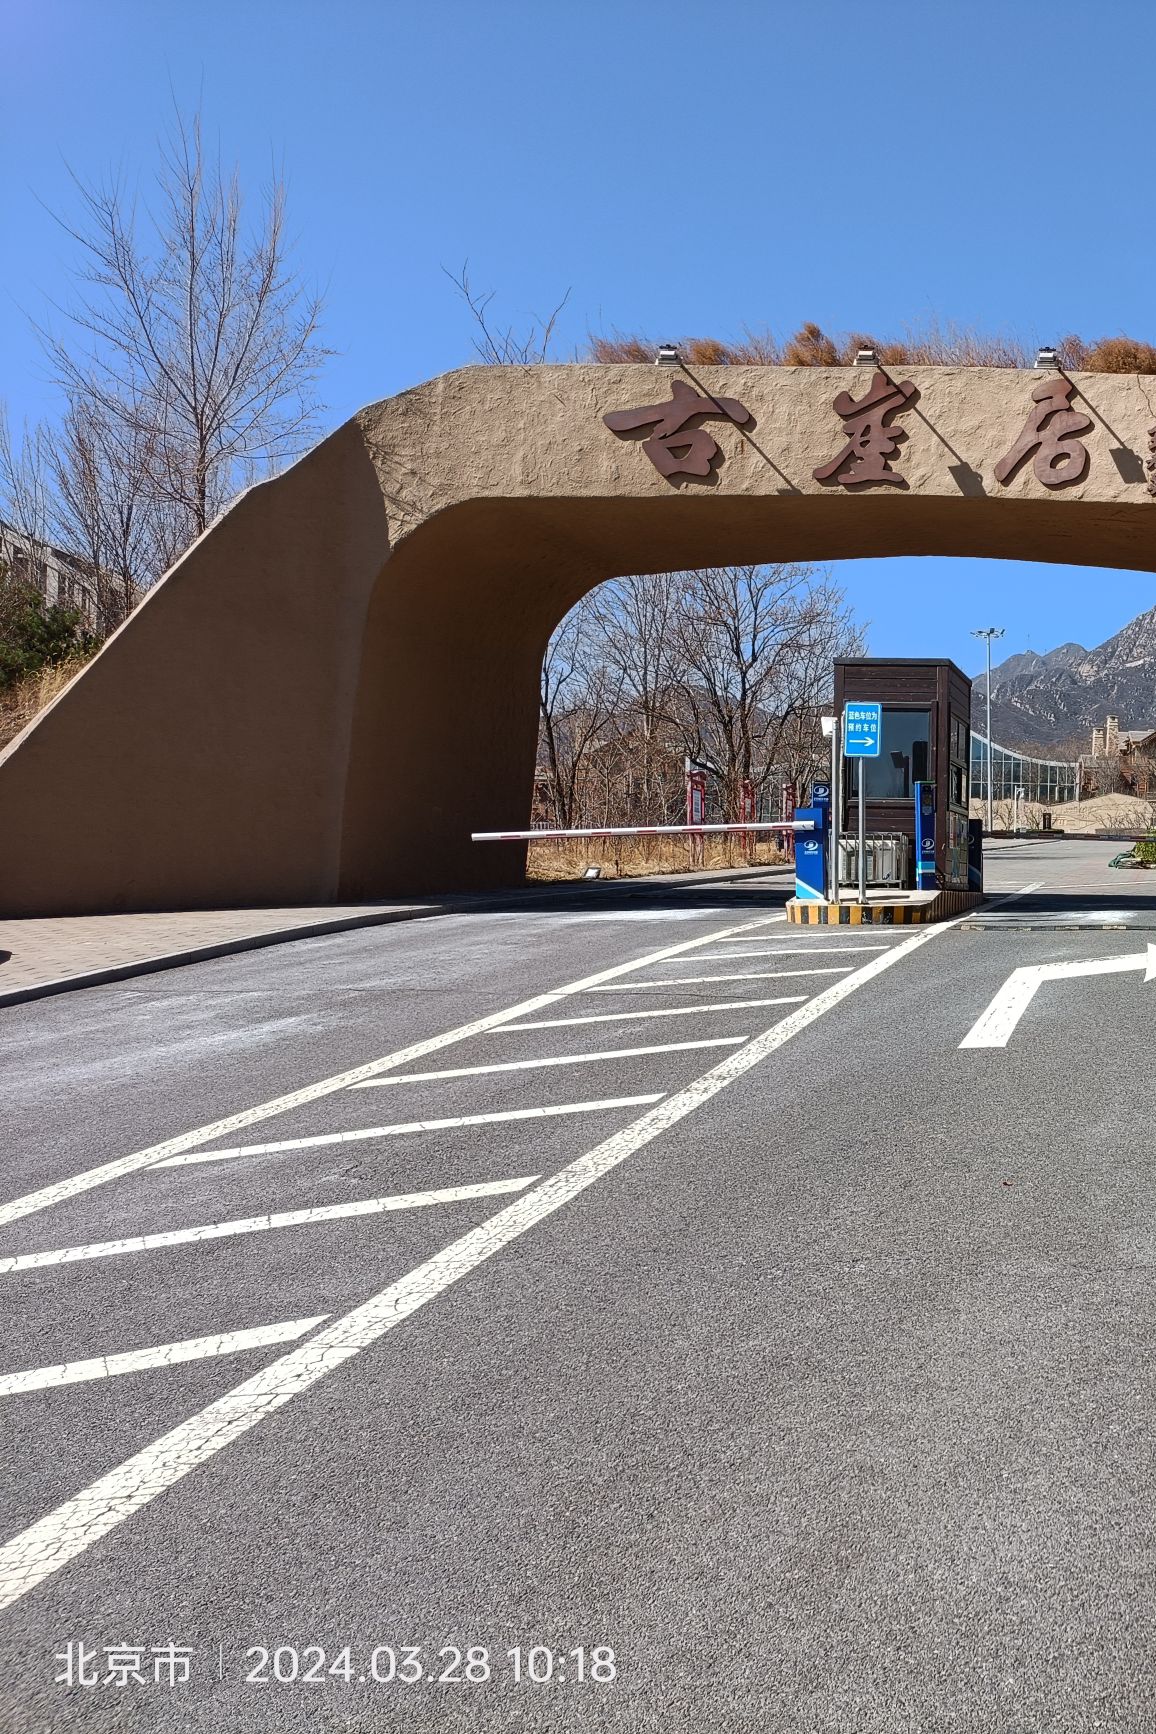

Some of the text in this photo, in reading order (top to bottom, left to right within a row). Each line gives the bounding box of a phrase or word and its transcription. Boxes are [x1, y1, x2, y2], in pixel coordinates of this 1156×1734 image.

[602, 372, 1093, 486] 古崖居
[848, 711, 878, 720] 蓝色车位为
[848, 723, 877, 732] 预约车位
